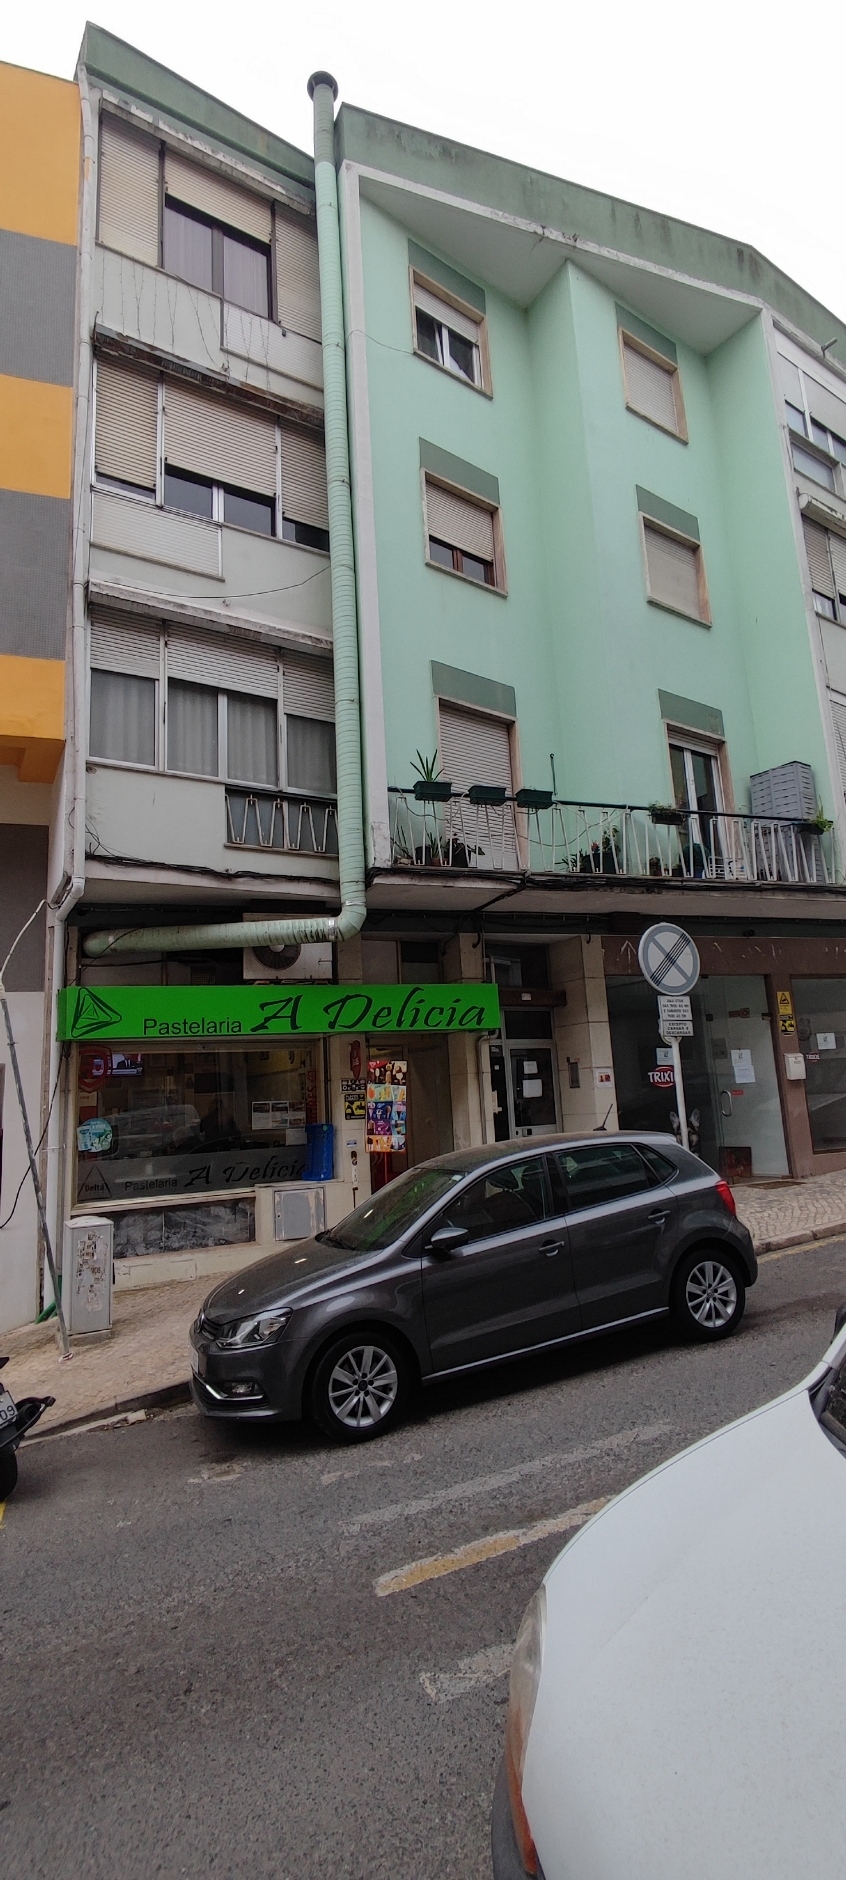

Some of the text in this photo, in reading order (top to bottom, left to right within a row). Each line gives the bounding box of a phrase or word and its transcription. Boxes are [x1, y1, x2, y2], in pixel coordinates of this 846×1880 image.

[143, 1017, 242, 1036] Pastelaria
[250, 994, 303, 1032] A
[648, 1071, 674, 1083] TRIXI
[125, 1178, 177, 1191] Pastelaria
[184, 1164, 211, 1187] A
